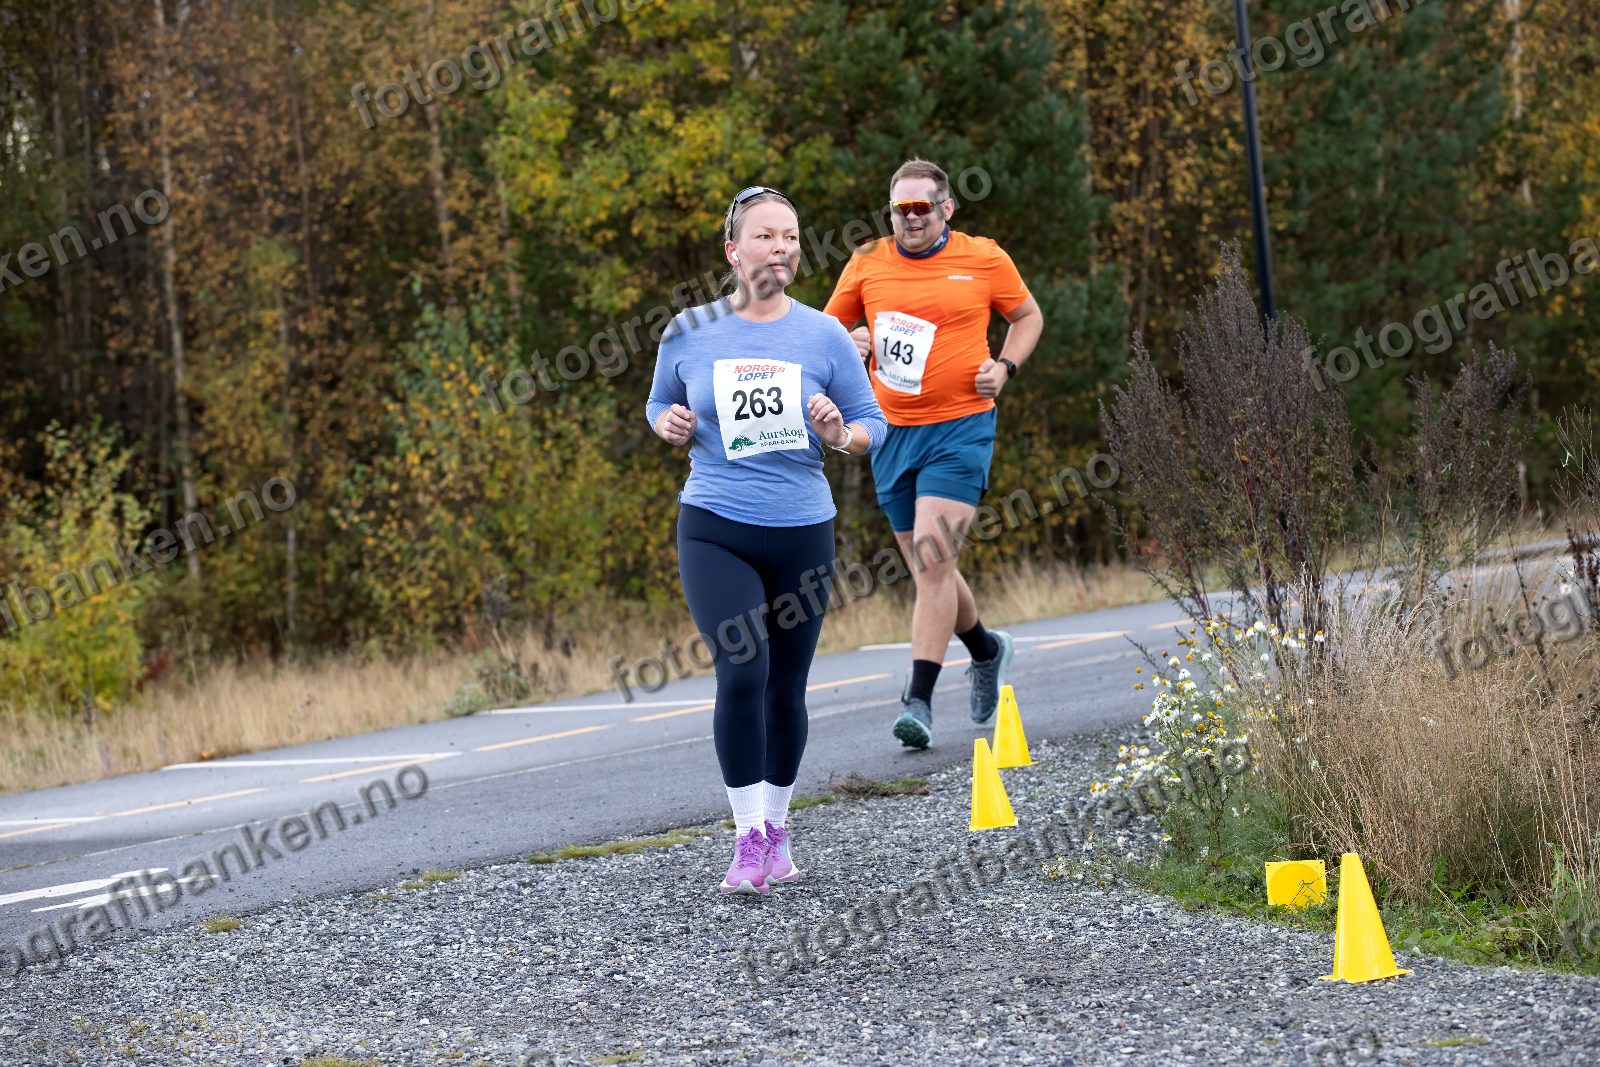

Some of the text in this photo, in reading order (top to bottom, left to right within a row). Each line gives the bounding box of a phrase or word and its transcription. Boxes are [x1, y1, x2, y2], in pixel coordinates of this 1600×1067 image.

[890, 316, 925, 332] NORGES
[882, 336, 914, 365] 143
[733, 365, 786, 374] NORGES
[737, 371, 776, 382] LØPET
[732, 386, 784, 421] 263
[759, 427, 805, 440] Aurskog
